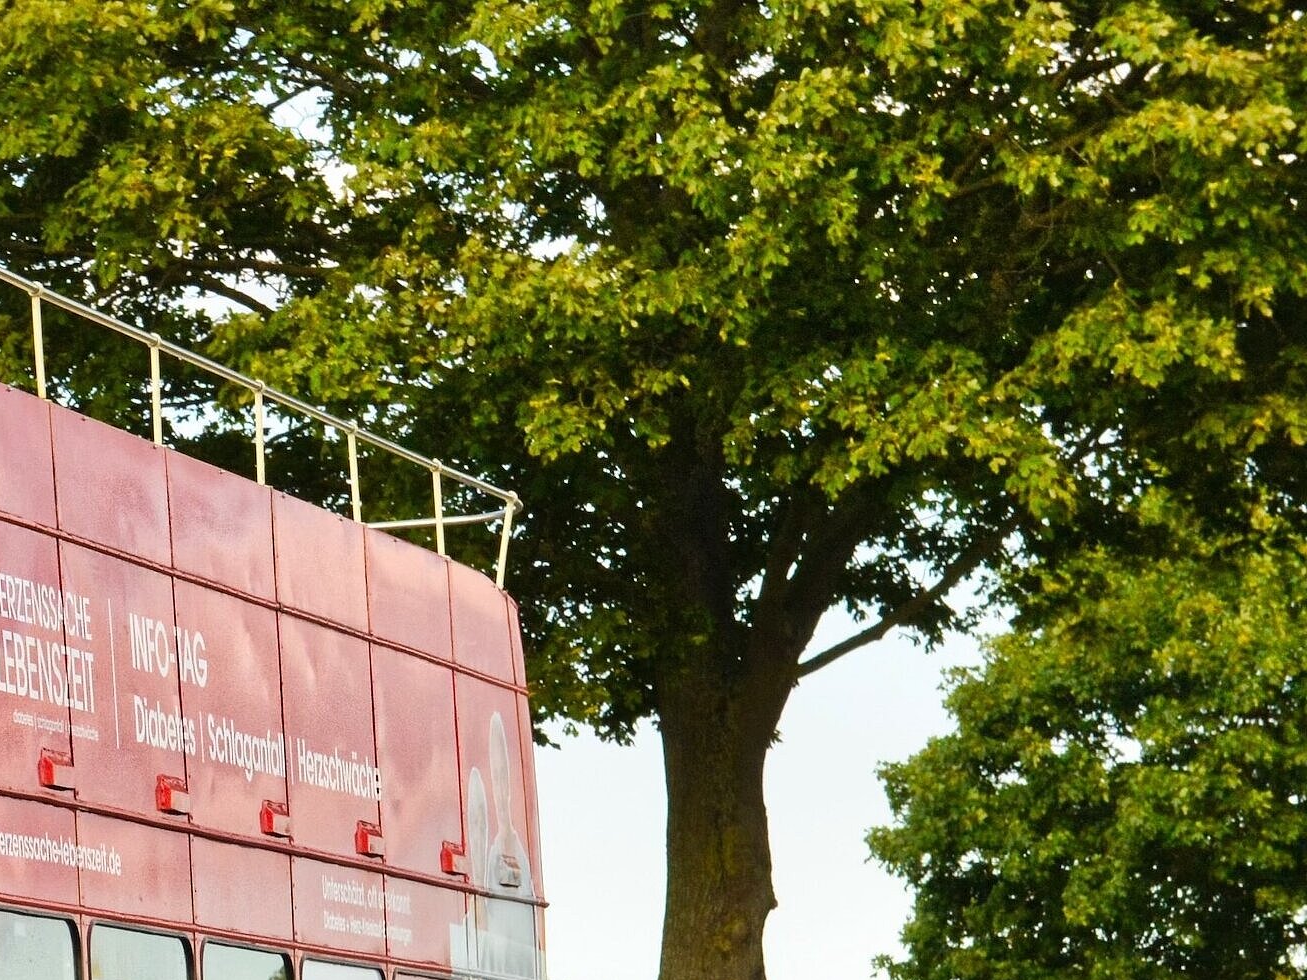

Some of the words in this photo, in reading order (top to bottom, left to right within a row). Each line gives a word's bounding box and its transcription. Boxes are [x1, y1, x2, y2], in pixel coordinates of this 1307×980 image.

[129, 612, 209, 688] INFO-TAG
[133, 694, 197, 757] Diabetes
[207, 713, 287, 783] Schlaganfall
[297, 737, 382, 802] Herzschwäche
